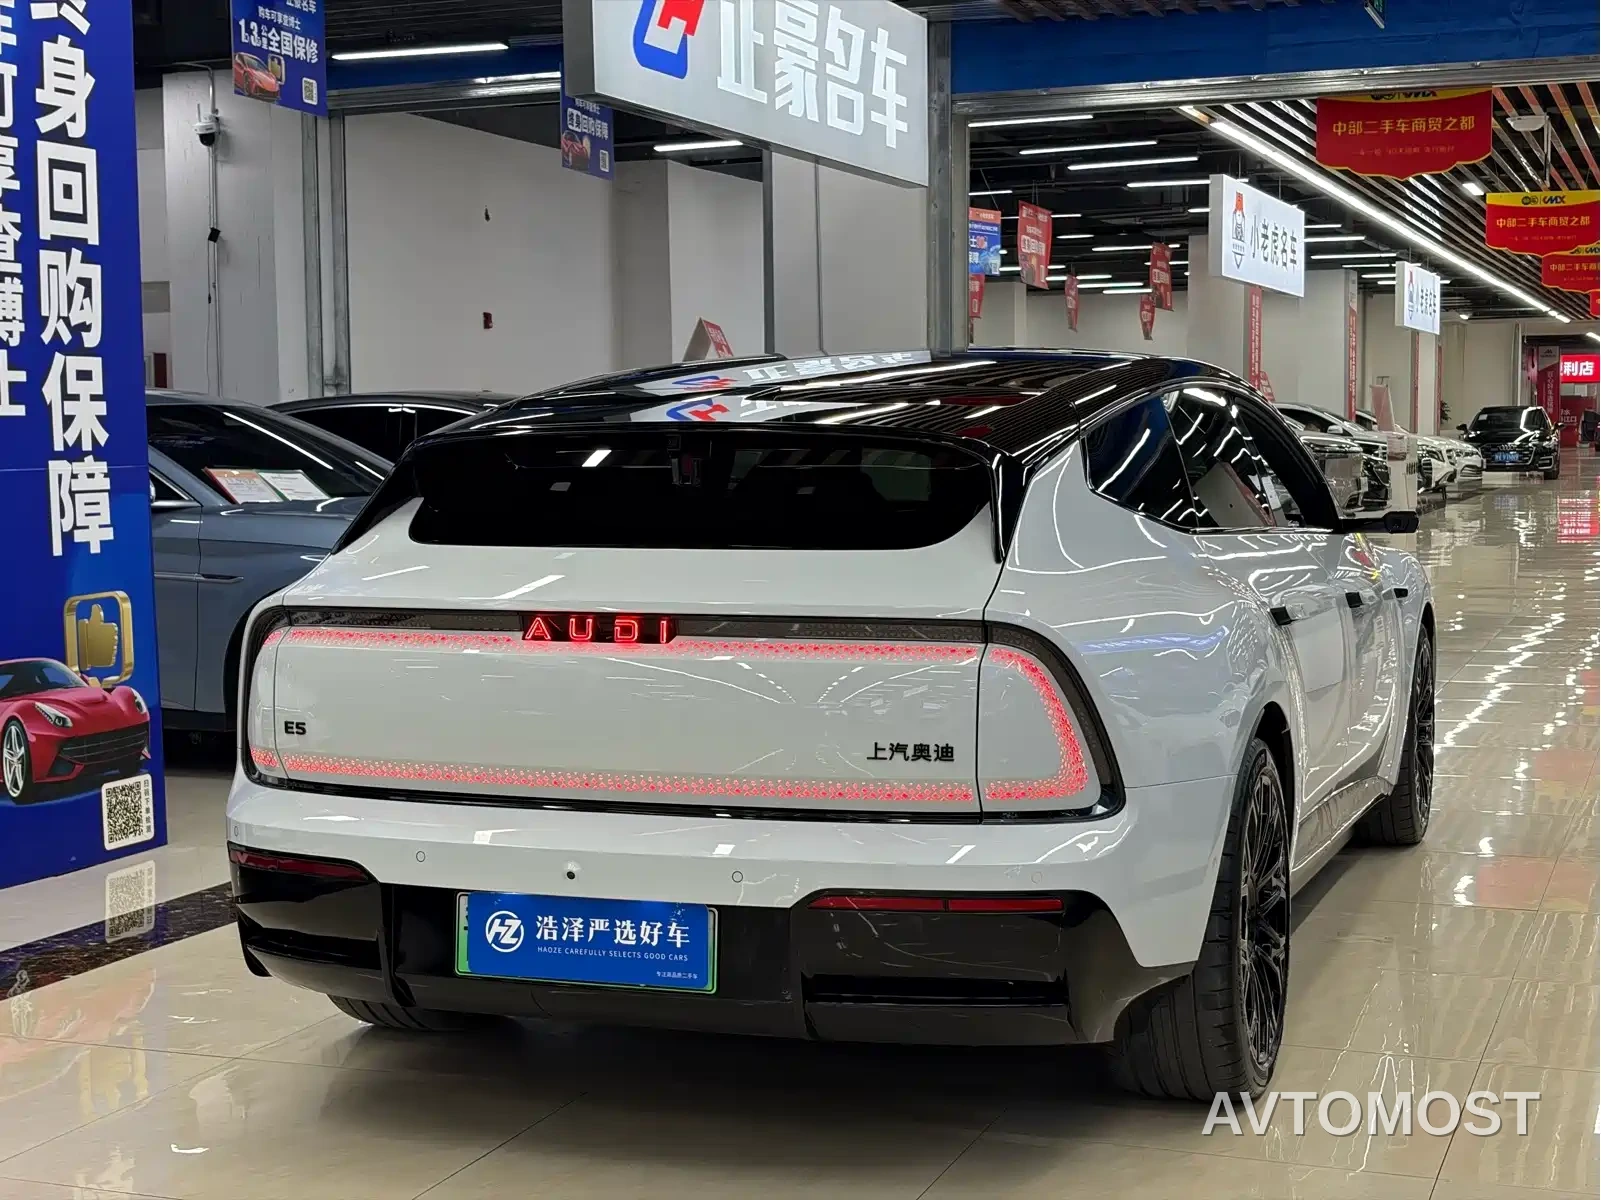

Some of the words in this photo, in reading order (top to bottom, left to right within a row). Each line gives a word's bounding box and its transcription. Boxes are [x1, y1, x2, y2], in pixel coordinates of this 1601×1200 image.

[717, 0, 908, 149] 正豪名车
[1333, 115, 1475, 136] 中部二手车商贸之都
[1496, 216, 1590, 228] 中部二手车商贸之都
[1250, 214, 1298, 274] 小老虎名车
[1560, 361, 1594, 376] 利店
[525, 617, 667, 643] AUDI
[284, 721, 307, 735] E5
[866, 742, 955, 762] 上汽奥迪
[536, 915, 690, 948] 浩泽严选好车
[537, 946, 562, 954] HAOZE
[564, 947, 606, 957] CAREFULLY
[609, 950, 641, 959] SELECTS
[668, 954, 688, 962] CARS
